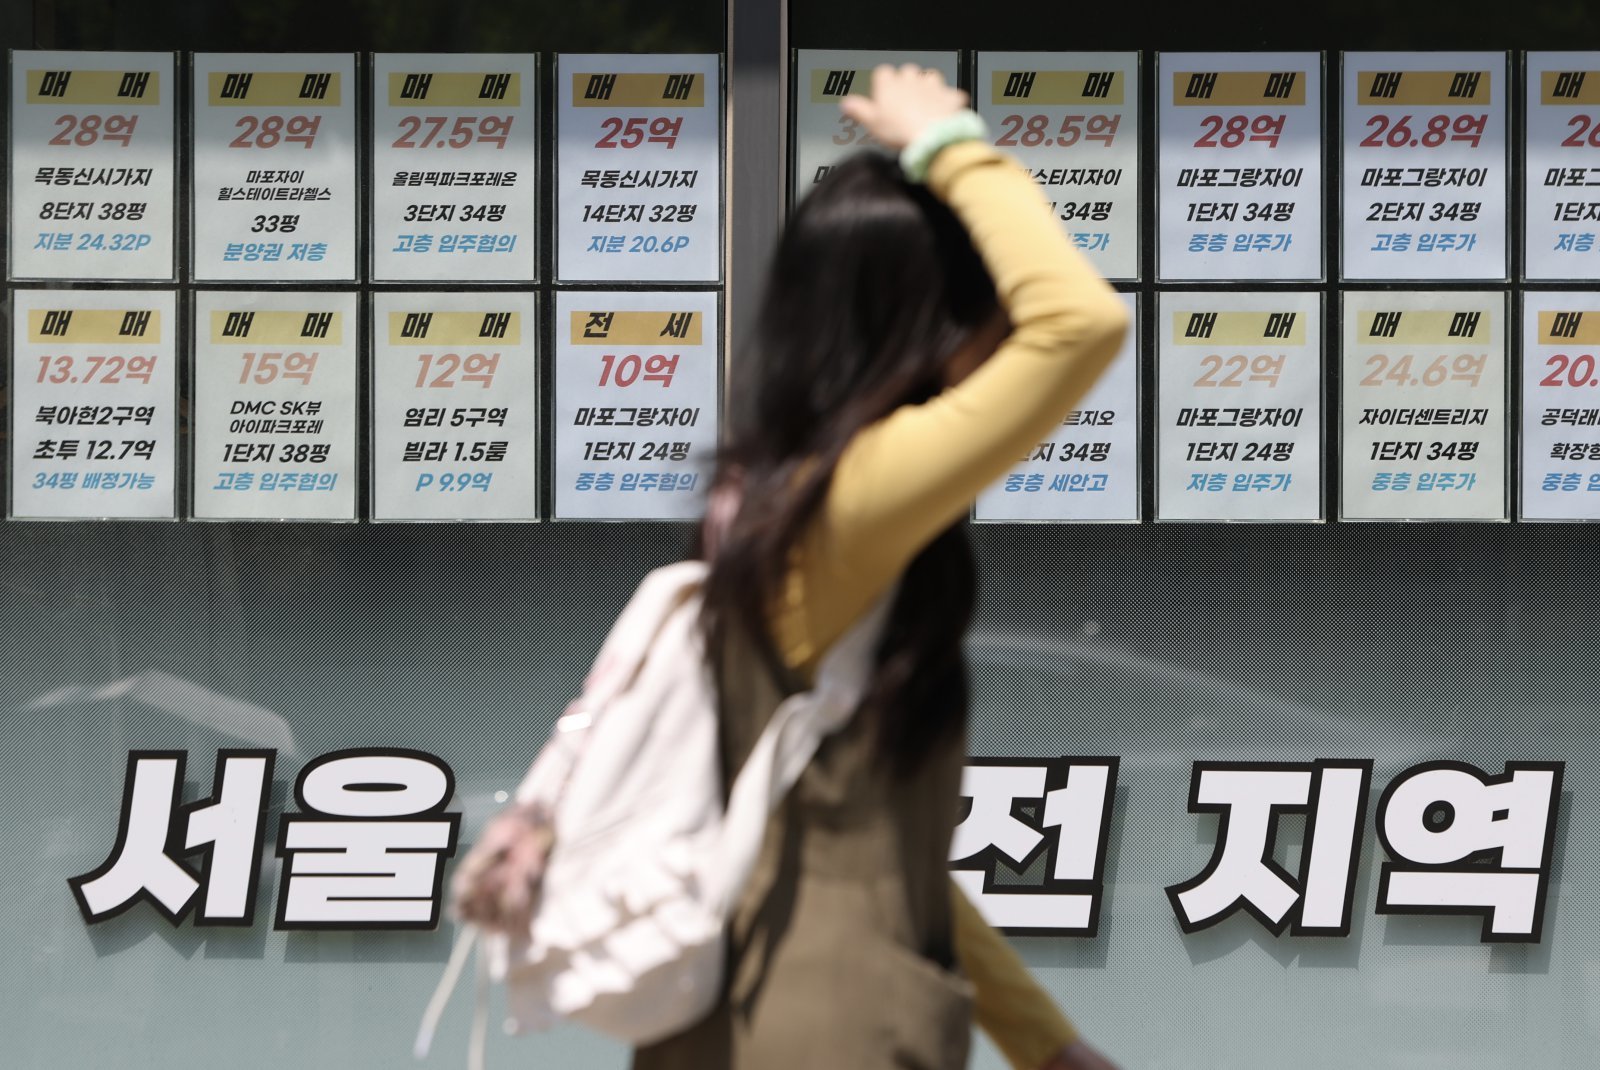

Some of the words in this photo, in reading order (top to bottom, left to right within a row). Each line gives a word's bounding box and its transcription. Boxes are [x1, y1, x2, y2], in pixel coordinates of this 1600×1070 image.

[38, 71, 72, 97] 매
[117, 72, 150, 98] 매
[221, 73, 253, 99] 매
[299, 73, 331, 99] 매
[400, 74, 433, 99] 매
[478, 74, 511, 99] 매
[585, 74, 617, 100] 매
[663, 74, 695, 100] 매
[823, 71, 856, 96] 매
[1004, 72, 1036, 98] 매
[1082, 72, 1114, 98] 매
[1185, 73, 1218, 99] 매
[1264, 72, 1296, 98] 매
[1370, 72, 1402, 98] 매
[1448, 72, 1481, 98] 매
[1553, 72, 1586, 98] 매
[48, 114, 138, 147] 28억
[229, 116, 321, 149] 28억
[392, 116, 514, 149] 27.5억
[595, 117, 683, 149] 25억
[995, 114, 1121, 148] 28.5억
[1194, 115, 1286, 148] 28억
[1360, 114, 1488, 148] 26.8억
[35, 168, 152, 186] 목동신시가지
[246, 170, 304, 184] 마포자이
[393, 172, 517, 186] 올림픽파크포레온
[581, 170, 698, 188] 목동신시가지
[1024, 169, 1122, 185] 스티지자이
[1177, 168, 1303, 187] 마포그랑자이
[1361, 168, 1488, 187] 마포그랑자이
[218, 187, 331, 201] 힐스테이트라첼스
[40, 202, 94, 220] 8단지
[98, 203, 147, 220] 38평
[404, 205, 457, 221] 3단지
[460, 205, 506, 222] 34평
[583, 205, 645, 222] 14단지
[649, 205, 697, 222] 32평
[1061, 202, 1113, 221] 34평
[1187, 203, 1239, 221] 1단지
[1242, 203, 1295, 221] 34평
[1366, 202, 1425, 221] 2단지
[1429, 202, 1481, 221] 34평
[251, 215, 300, 233] 33평
[34, 233, 73, 250] 지분
[76, 233, 151, 251] 24.32P
[393, 234, 434, 252] 고층
[438, 235, 517, 253] 입주협의
[587, 236, 626, 252] 지분
[629, 236, 689, 253] 20.6P
[1068, 233, 1110, 251] 주가
[1188, 233, 1228, 252] 중층
[1233, 234, 1292, 252] 입주가
[1371, 233, 1412, 252] 고층
[1416, 234, 1476, 252] 입주가
[1554, 233, 1595, 252] 저층
[224, 243, 283, 261] 분양권
[286, 243, 327, 261] 저층
[41, 310, 73, 336] 매
[119, 311, 151, 336] 매
[222, 312, 255, 337] 매
[301, 312, 333, 338] 매
[401, 313, 433, 338] 매
[479, 313, 511, 338] 매
[584, 312, 614, 338] 전
[660, 312, 693, 338] 세
[1185, 313, 1217, 338] 매
[1264, 313, 1296, 338] 매
[1369, 312, 1402, 337] 매
[1448, 312, 1481, 337] 매
[1550, 312, 1583, 338] 매
[37, 356, 157, 384] 13.72억
[239, 352, 318, 385] 15억
[415, 353, 500, 389] 12억
[599, 355, 680, 387] 10억
[1193, 354, 1286, 388] 22억
[1359, 354, 1487, 387] 24.6억
[1539, 354, 1600, 387] 20.
[36, 406, 155, 425] 북아현2구역
[230, 401, 276, 415] DMC
[279, 401, 321, 415] SK뷰
[404, 408, 447, 427] 염리
[450, 408, 508, 427] 5구역
[574, 408, 699, 427] 마포그랑자이
[1176, 408, 1303, 427] 마포그랑자이
[1359, 409, 1488, 425] 자이더센트리지
[1541, 408, 1600, 427] 공덕래
[230, 419, 323, 434] 아이파크포레
[1063, 411, 1115, 426] 르지오
[33, 440, 80, 460] 초투
[87, 440, 156, 460] 12.7억
[224, 444, 275, 462] 1단지
[279, 444, 331, 463] 38평
[403, 442, 447, 461] 빌라
[455, 441, 508, 461] 1.5룸
[584, 442, 636, 461] 1단지
[638, 442, 692, 461] 24평
[1060, 443, 1111, 462] 34평
[1187, 442, 1238, 461] 1단지
[1242, 443, 1294, 461] 24평
[1371, 442, 1422, 460] 1단지
[1426, 442, 1479, 460] 34평
[32, 472, 79, 489] 34평
[82, 472, 154, 490] 배정가능
[213, 472, 255, 490] 고층
[259, 473, 338, 491] 입주협의
[416, 473, 434, 491] P
[440, 473, 492, 492] 9.9억
[576, 472, 615, 491] 중층
[618, 473, 699, 492] 입주협의
[1005, 474, 1044, 492] 중층
[1048, 474, 1108, 492] 세안고
[1187, 473, 1228, 491] 저층
[1232, 474, 1291, 492] 입주가
[1372, 472, 1412, 491] 중층
[1416, 473, 1476, 491] 입주가
[1542, 473, 1582, 491] 중층
[67, 747, 462, 931] 서울
[1165, 758, 1565, 943] 지역
